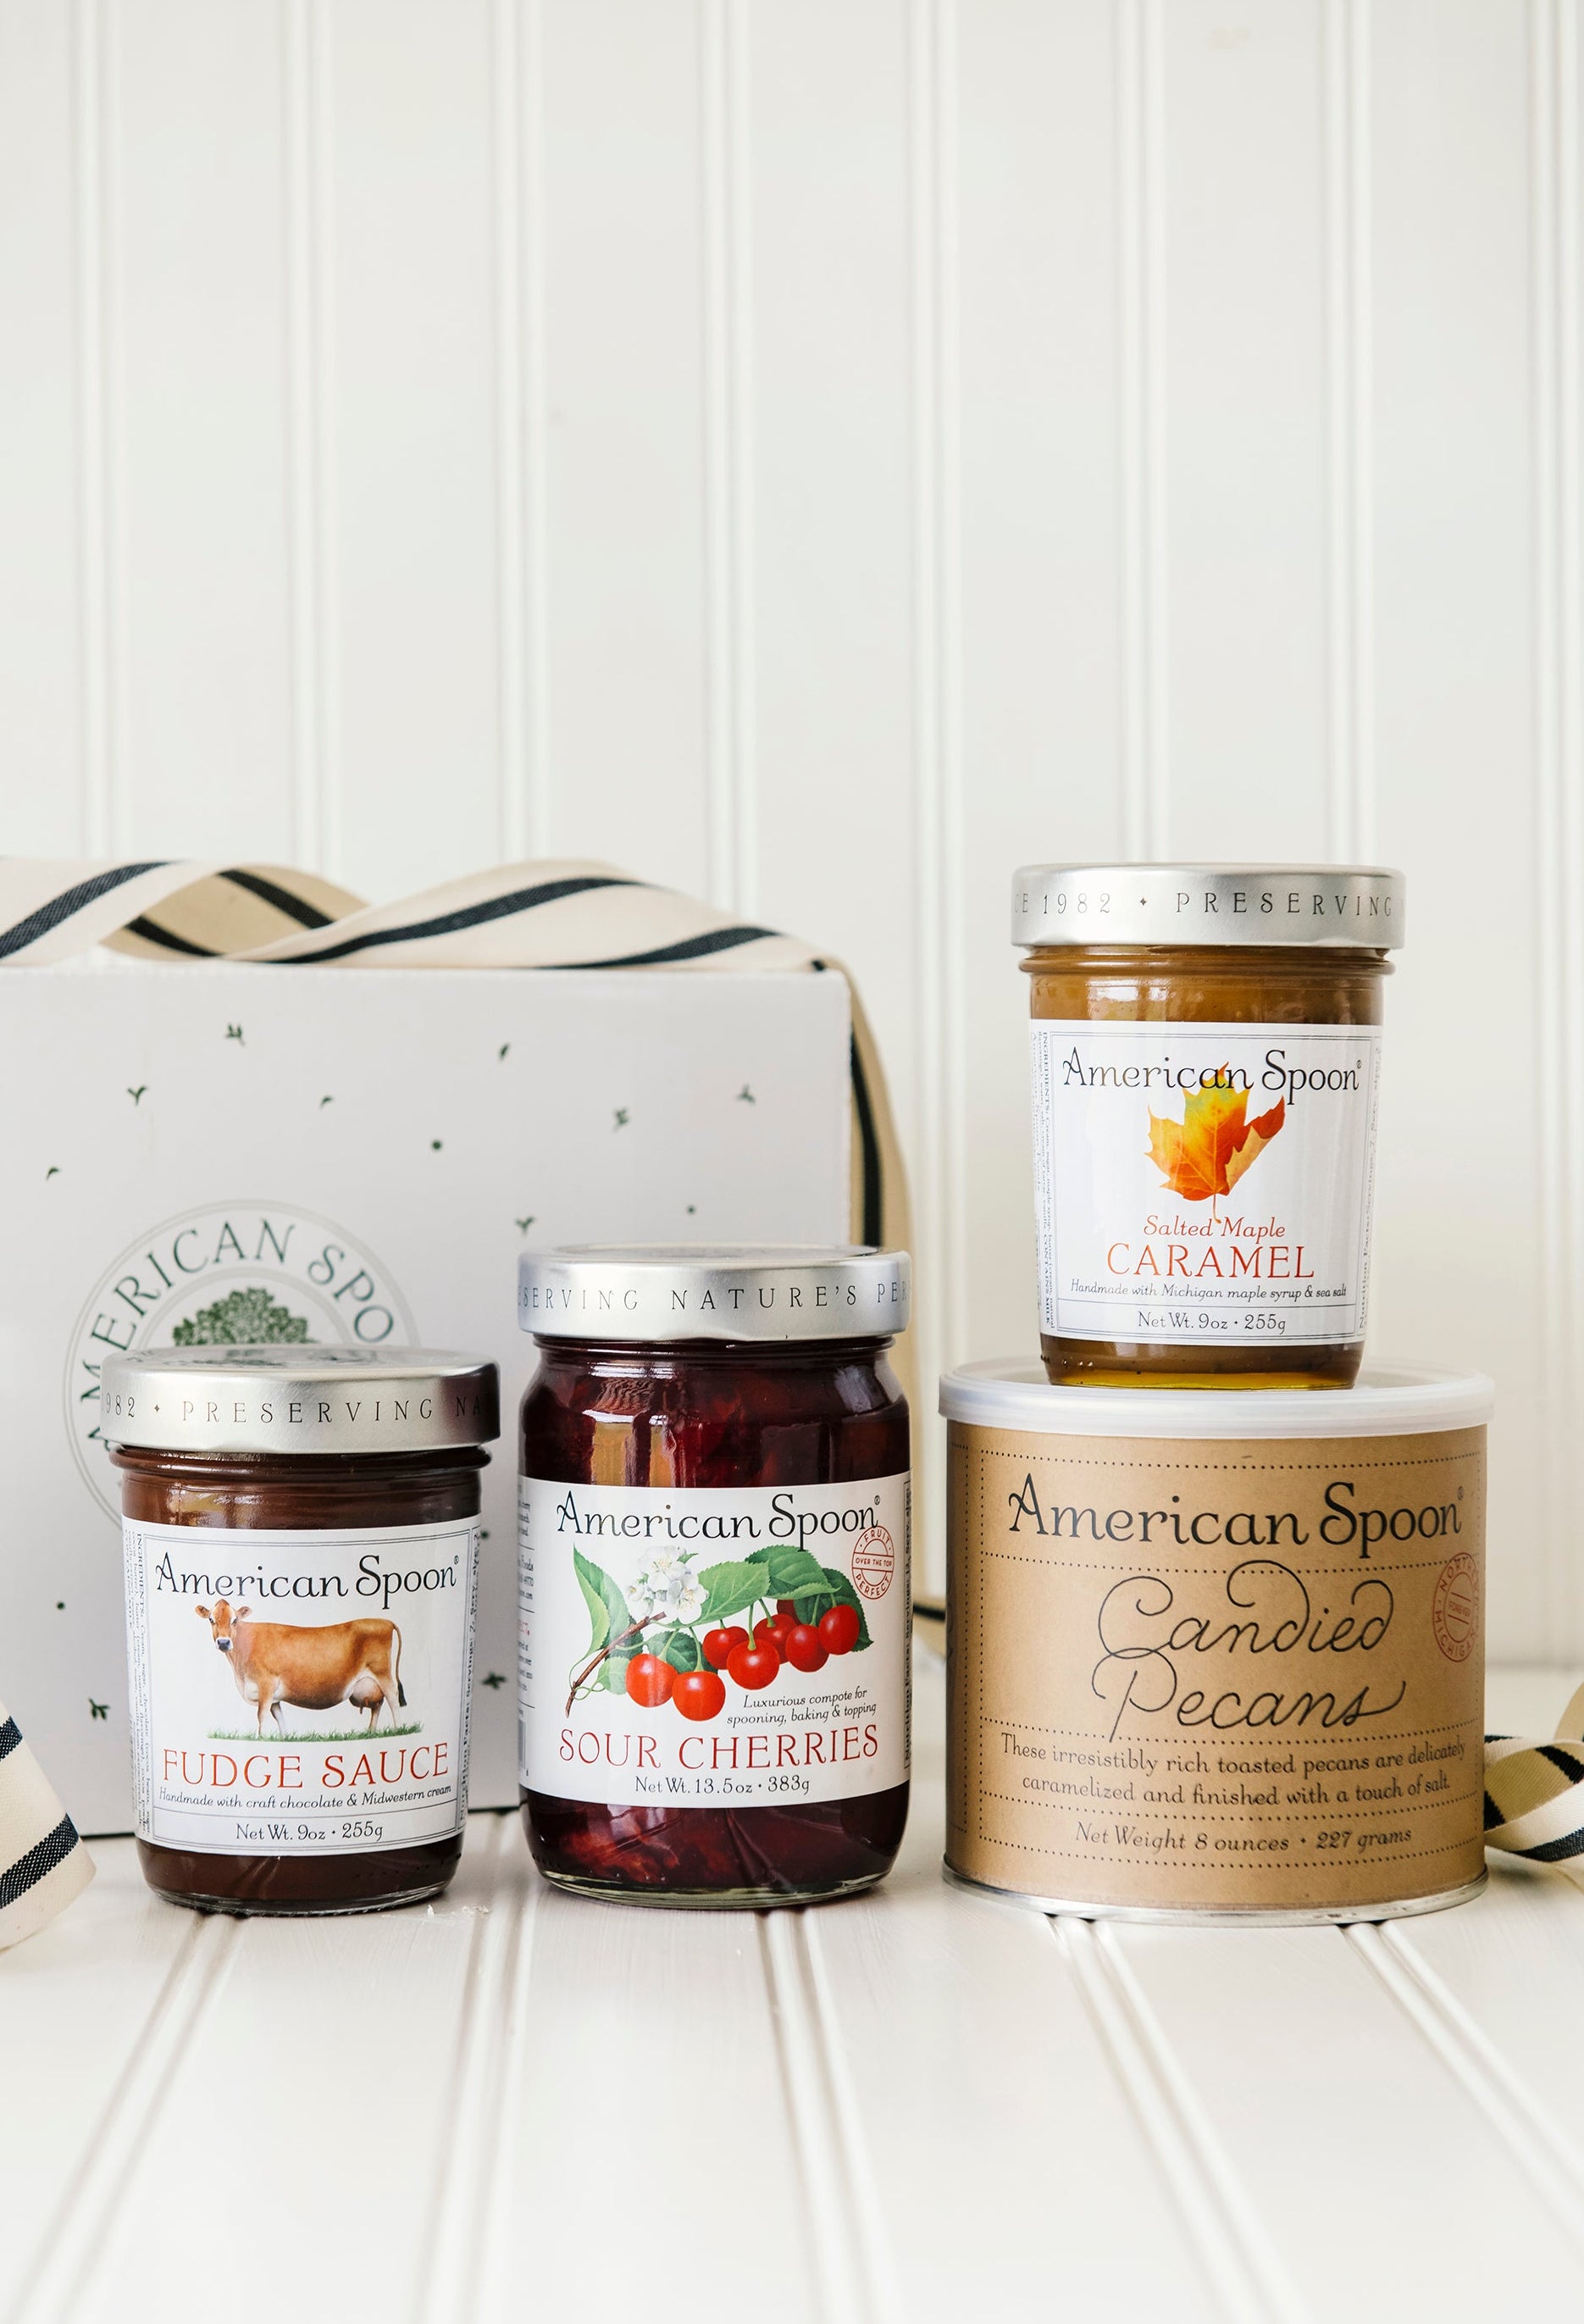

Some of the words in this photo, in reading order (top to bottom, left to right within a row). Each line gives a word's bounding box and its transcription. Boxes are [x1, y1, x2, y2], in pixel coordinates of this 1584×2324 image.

[1043, 892, 1111, 914] 1982
[1177, 891, 1393, 918] PRESERVING
[1062, 1046, 1255, 1090] American
[1144, 1215, 1212, 1238] Salted
[1221, 1217, 1286, 1245] Maple
[1106, 1242, 1315, 1279] CARAMEL
[1071, 1278, 1129, 1296] Handmade
[1132, 1282, 1157, 1297] with
[1161, 1284, 1223, 1301] Michigan
[1227, 1285, 1267, 1304] maple
[1270, 1287, 1302, 1303] syrup
[1304, 1284, 1314, 1298] &
[1315, 1287, 1331, 1298] sea
[1332, 1285, 1347, 1298] salt
[80, 1218, 296, 1451] ERICAN
[1138, 1311, 1166, 1328] Net
[1168, 1312, 1195, 1330] Wt.
[1198, 1312, 1229, 1330] 9oz
[1244, 1313, 1287, 1336] 255g
[183, 1398, 434, 1424] PRESERVING
[556, 1490, 762, 1539] American
[1008, 1473, 1310, 1545] American
[864, 1528, 890, 1544] FRUIT
[155, 1552, 349, 1598] American
[855, 1573, 890, 1597] PERFECT
[1098, 1560, 1395, 1660] Candied
[742, 1694, 806, 1708] Luxurious
[808, 1689, 853, 1706] compote
[854, 1686, 868, 1700] for
[1091, 1647, 1407, 1743] Pecans
[726, 1711, 787, 1729] spooning,
[790, 1706, 829, 1726] baking
[831, 1705, 841, 1718] &
[843, 1700, 877, 1721] topping
[558, 1728, 662, 1769] SOUR
[678, 1723, 879, 1770] CHERRIES
[1000, 1732, 1047, 1761] These
[1052, 1744, 1158, 1778] irresistibly
[1166, 1748, 1211, 1774] rich
[1217, 1750, 1295, 1774] toasted
[1303, 1753, 1370, 1780] pecans
[1374, 1753, 1404, 1771] are
[1407, 1739, 1467, 1768] delicately
[163, 1748, 303, 1789] FUDGE
[322, 1742, 449, 1789] SAUCE
[159, 1787, 213, 1806] Handmade
[217, 1792, 242, 1808] with
[246, 1794, 276, 1810] craft
[280, 1794, 343, 1810] chocolate
[346, 1793, 357, 1806] &
[362, 1789, 425, 1806] Midwestern
[427, 1785, 451, 1798] cream
[634, 1775, 663, 1794] Net
[665, 1776, 691, 1794] Wt.
[695, 1778, 753, 1794] 13.5oz
[767, 1774, 810, 1795] 383g
[1022, 1774, 1135, 1803] caramelized
[1143, 1781, 1184, 1805] and
[1192, 1783, 1279, 1806] finished
[1286, 1783, 1330, 1805] with
[1335, 1790, 1349, 1804] a
[1354, 1779, 1404, 1802] touch
[1408, 1776, 1425, 1796] of
[1425, 1772, 1451, 1794] salt.
[235, 1823, 264, 1840] Net
[267, 1823, 293, 1840] Wt.
[297, 1824, 326, 1840] 9oz
[341, 1822, 384, 1843] 255g
[1076, 1820, 1109, 1844] Net
[1114, 1822, 1188, 1850] Weight
[1194, 1830, 1209, 1850] 8
[1214, 1836, 1290, 1852] ounces
[1315, 1830, 1354, 1850] 227
[1357, 1828, 1413, 1856] grams
